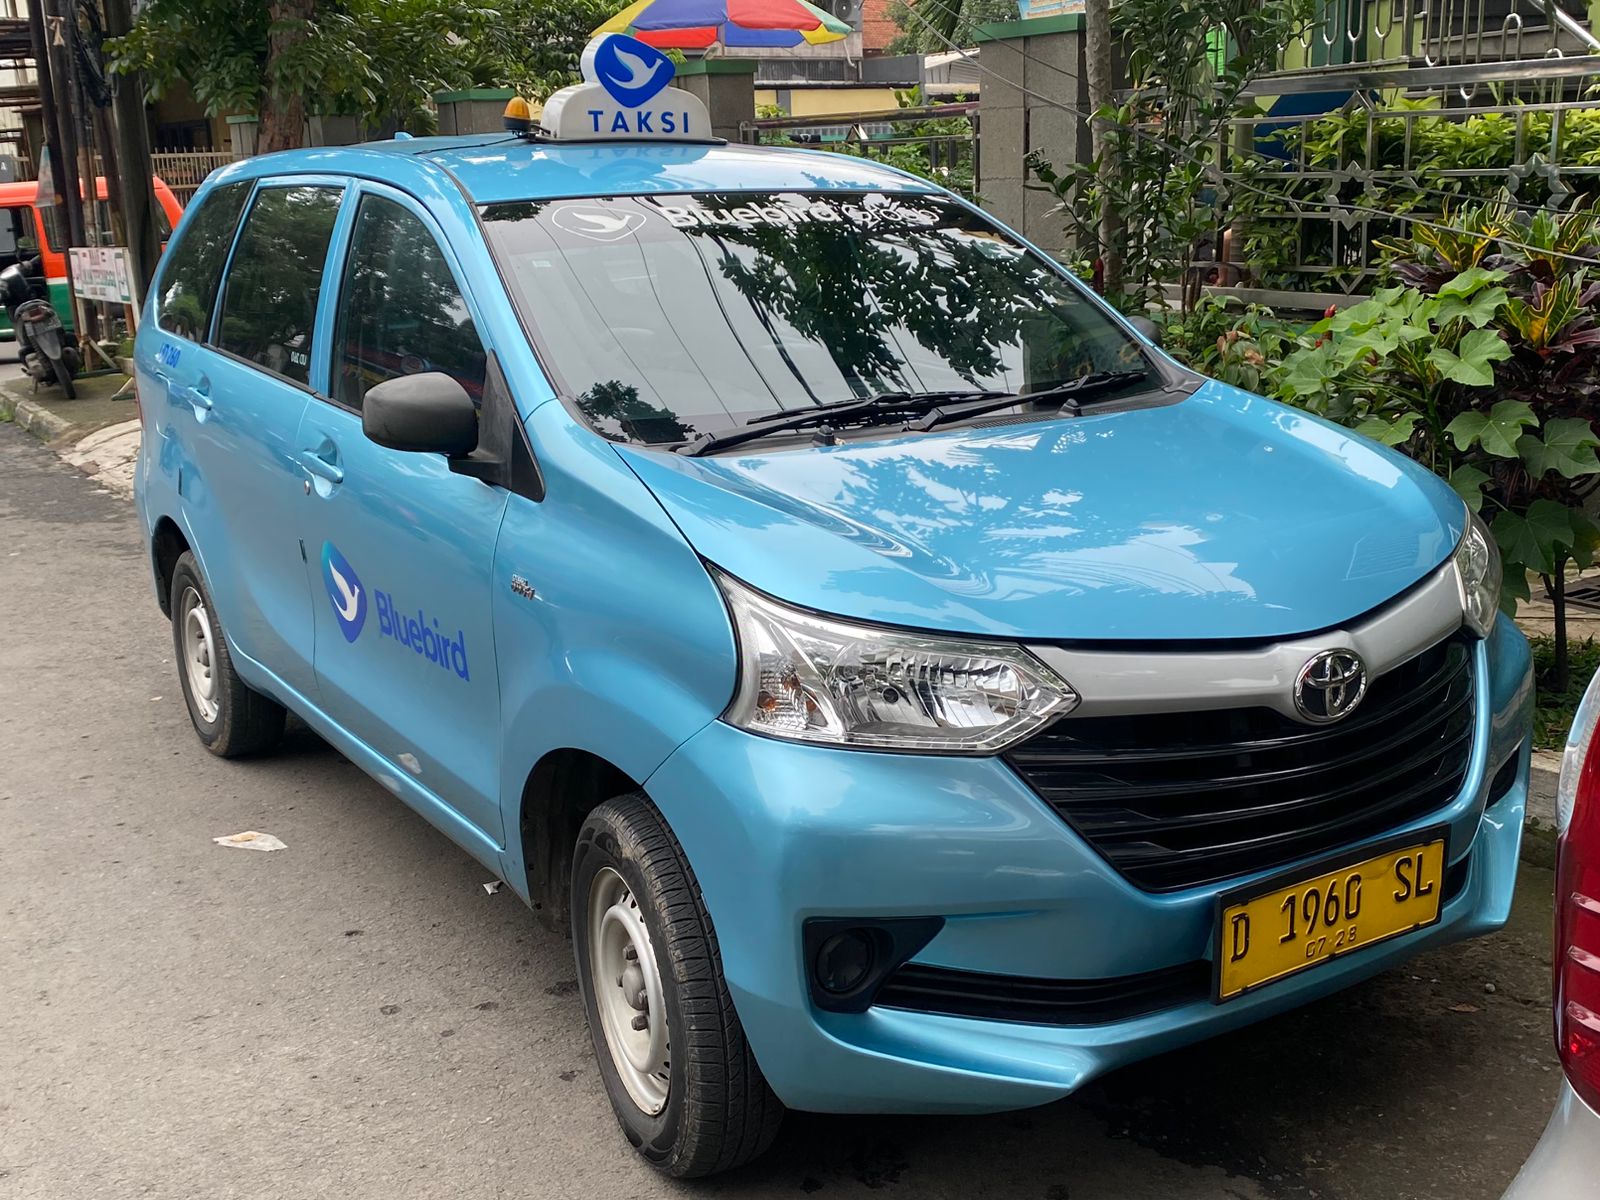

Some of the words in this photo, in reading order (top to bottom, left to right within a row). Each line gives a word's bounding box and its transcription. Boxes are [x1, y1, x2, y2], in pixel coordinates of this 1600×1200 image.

[588, 110, 689, 133] TAKSI
[659, 200, 842, 227] Bluebird
[375, 589, 470, 682] Bluebird
[1231, 911, 1250, 962] D
[1279, 872, 1362, 945] 1960
[1393, 852, 1433, 903] SL
